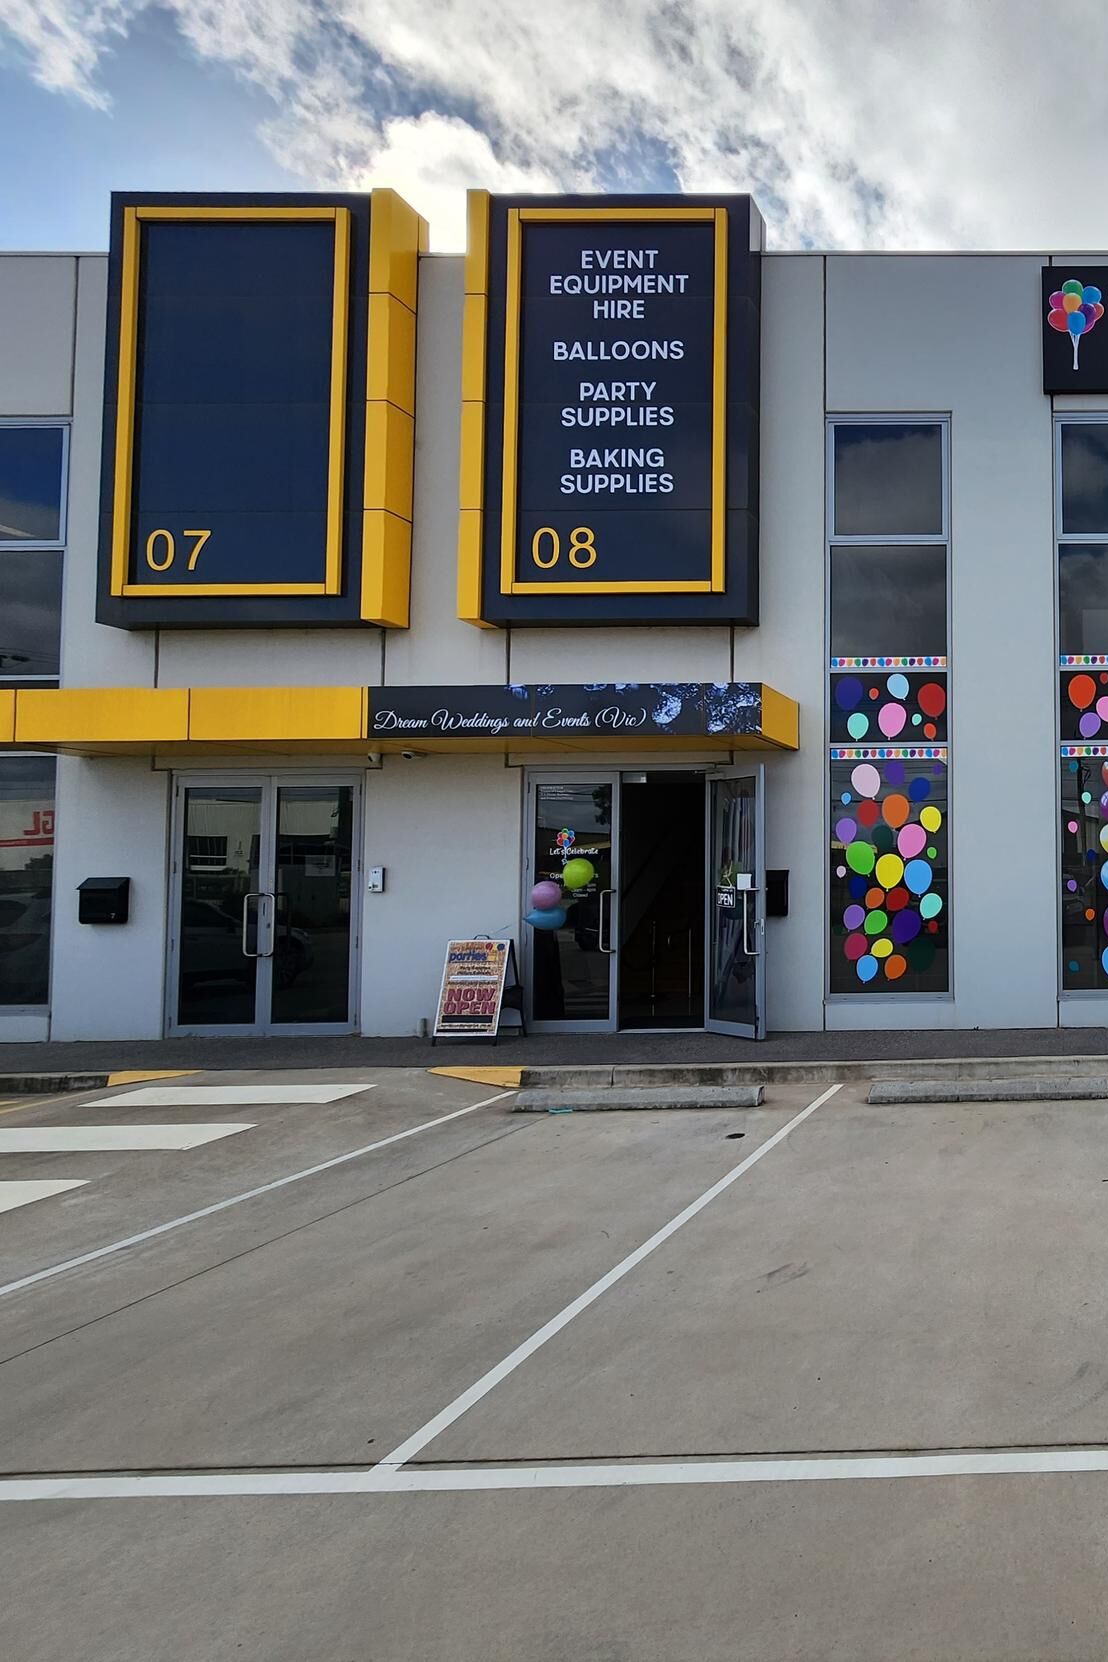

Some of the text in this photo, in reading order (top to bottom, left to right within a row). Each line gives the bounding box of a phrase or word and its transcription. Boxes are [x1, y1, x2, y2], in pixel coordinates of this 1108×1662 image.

[581, 249, 659, 269] EVENT
[550, 274, 689, 295] EQUIPMENT
[593, 300, 645, 319] HIRE
[553, 340, 685, 361] BALLOONS
[579, 381, 657, 402] PARTY
[561, 406, 675, 427] SUPPLIES
[570, 447, 665, 468] BAKING
[560, 473, 674, 494] SUPPLIES
[146, 529, 211, 571] 07
[532, 526, 597, 569] 08
[373, 706, 647, 735] Dream Weddings and Events (Vic)
[566, 847, 599, 855] Celebrate
[447, 988, 496, 1002] NOW
[443, 1001, 497, 1015] OPEN
